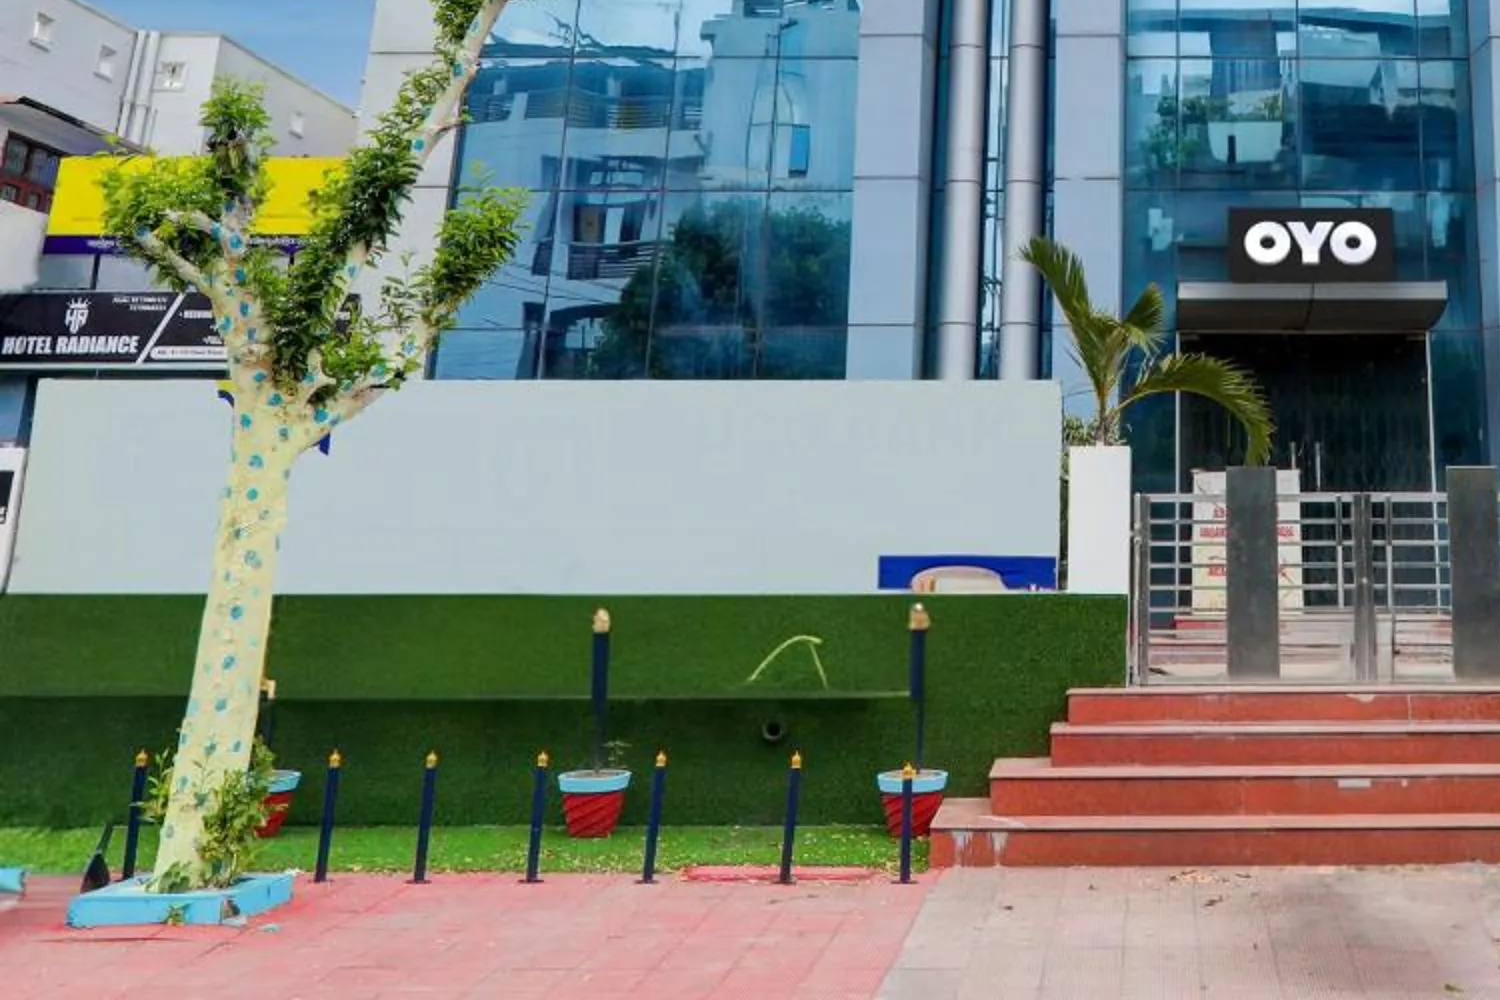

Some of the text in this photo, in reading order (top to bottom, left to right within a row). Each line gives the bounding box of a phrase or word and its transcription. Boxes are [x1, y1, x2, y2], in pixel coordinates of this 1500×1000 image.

[1244, 221, 1377, 265] OYO
[1, 336, 52, 355] HOTEL
[55, 335, 140, 354] RADIANCE
